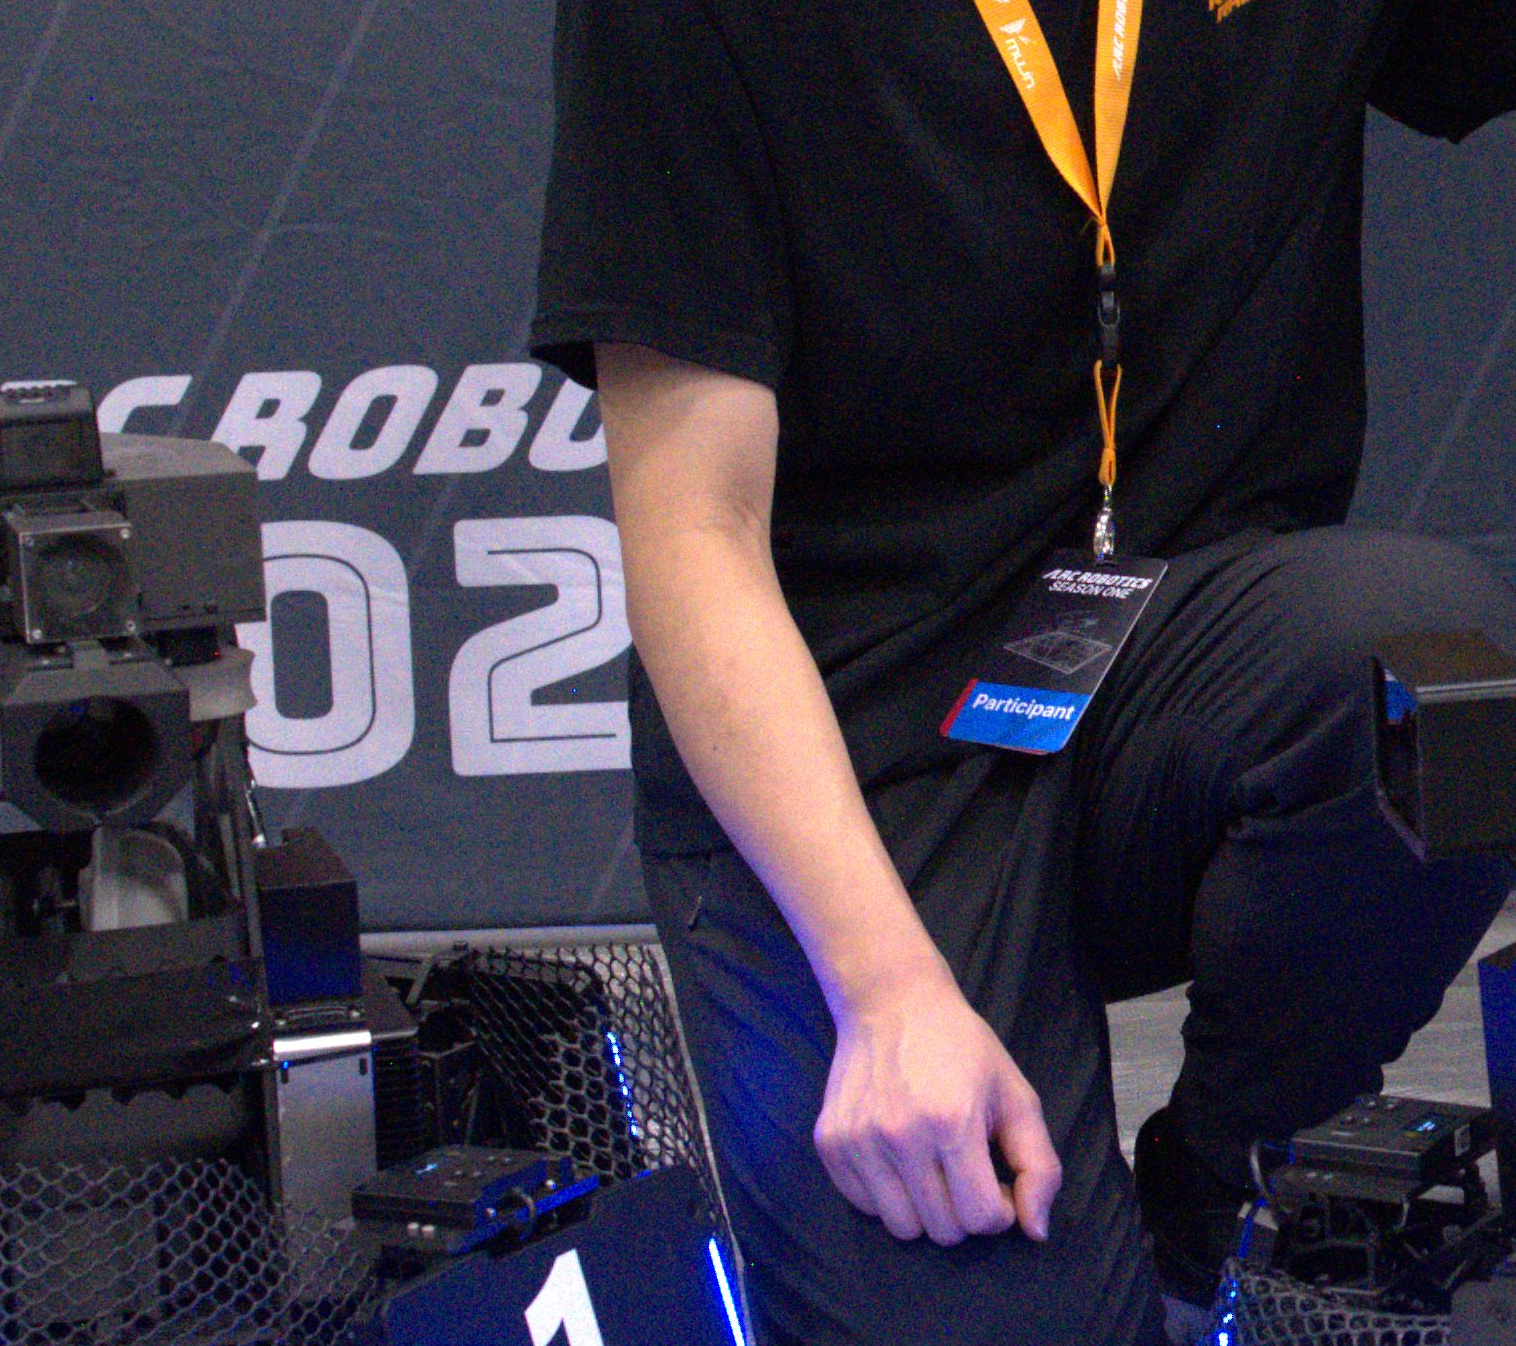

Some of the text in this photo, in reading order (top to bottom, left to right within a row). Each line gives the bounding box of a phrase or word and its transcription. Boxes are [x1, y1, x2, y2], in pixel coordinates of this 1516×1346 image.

[1042, 568, 1153, 589] ARC ROBOTICS
[1049, 580, 1134, 599] SEASON ONE
[972, 693, 1075, 720] Participant
